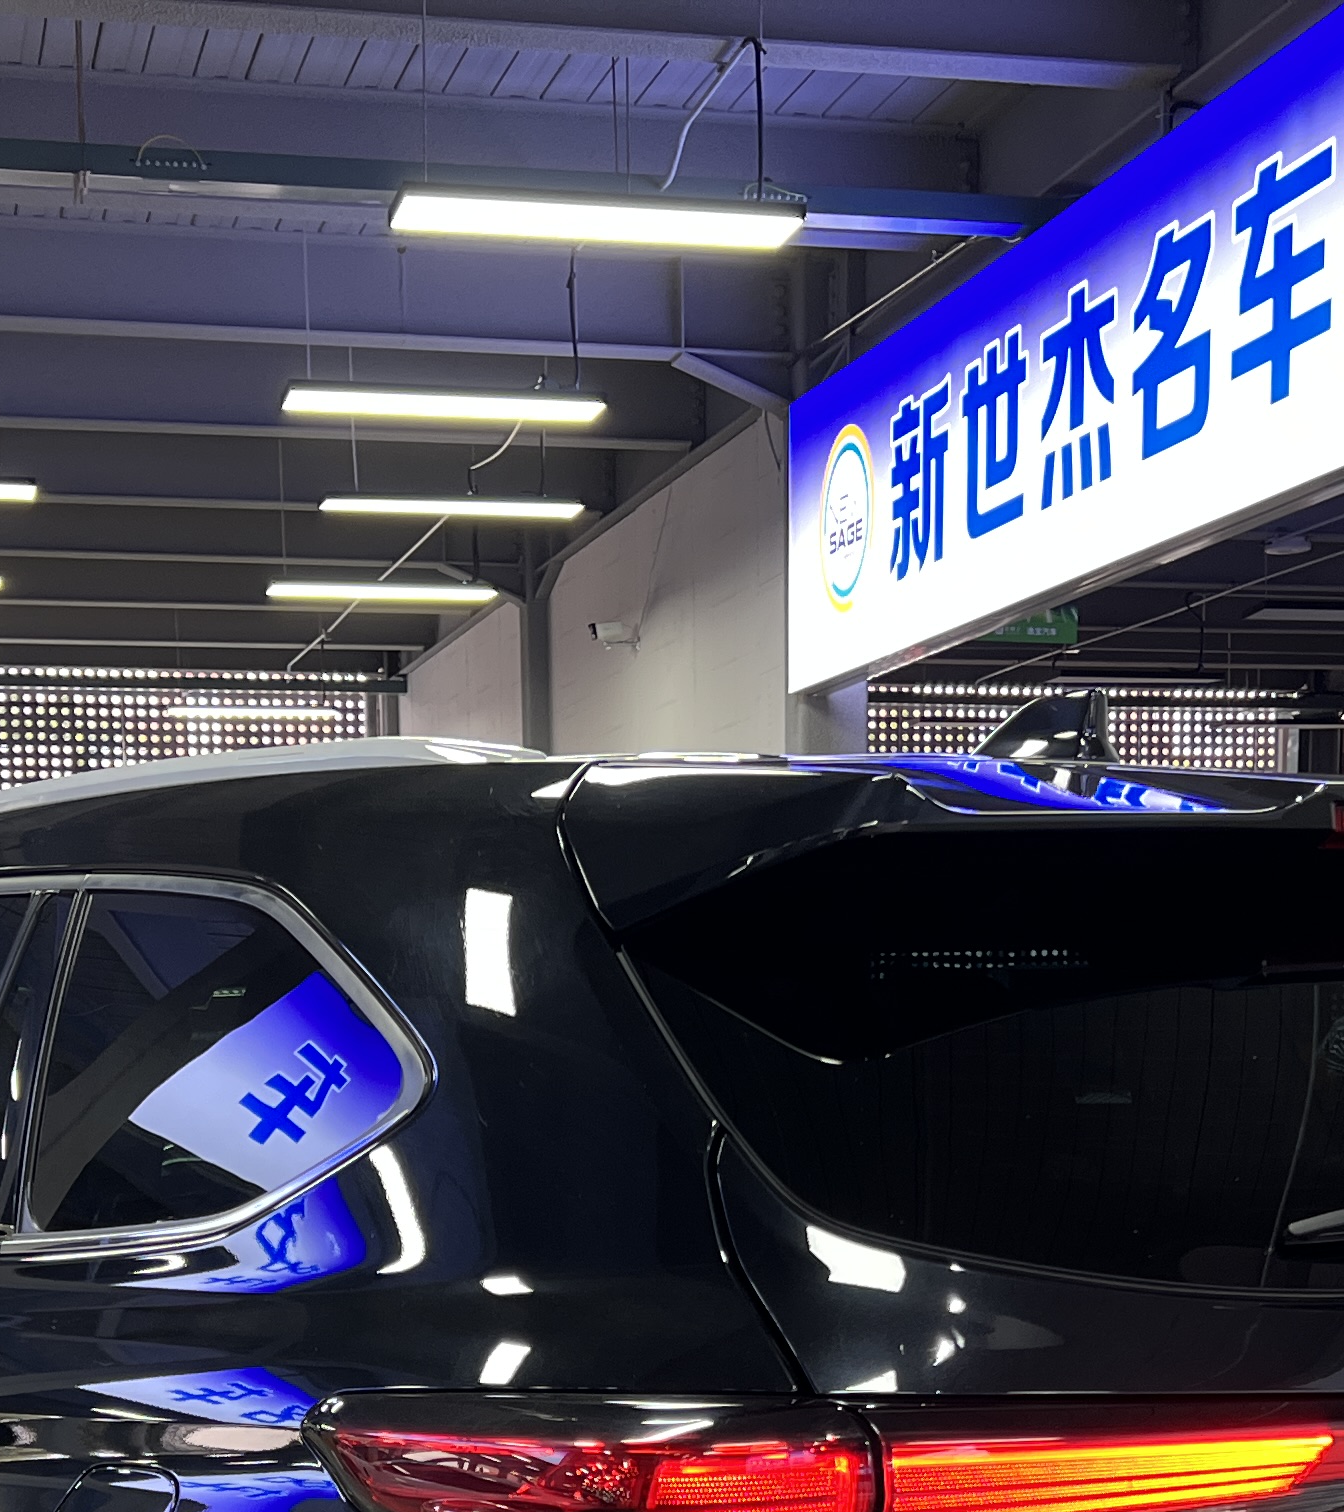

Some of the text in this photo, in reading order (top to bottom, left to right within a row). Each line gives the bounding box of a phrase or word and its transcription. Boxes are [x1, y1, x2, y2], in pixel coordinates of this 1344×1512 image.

[888, 136, 1338, 582] 新世杰名车
[829, 517, 863, 555] SAGE
